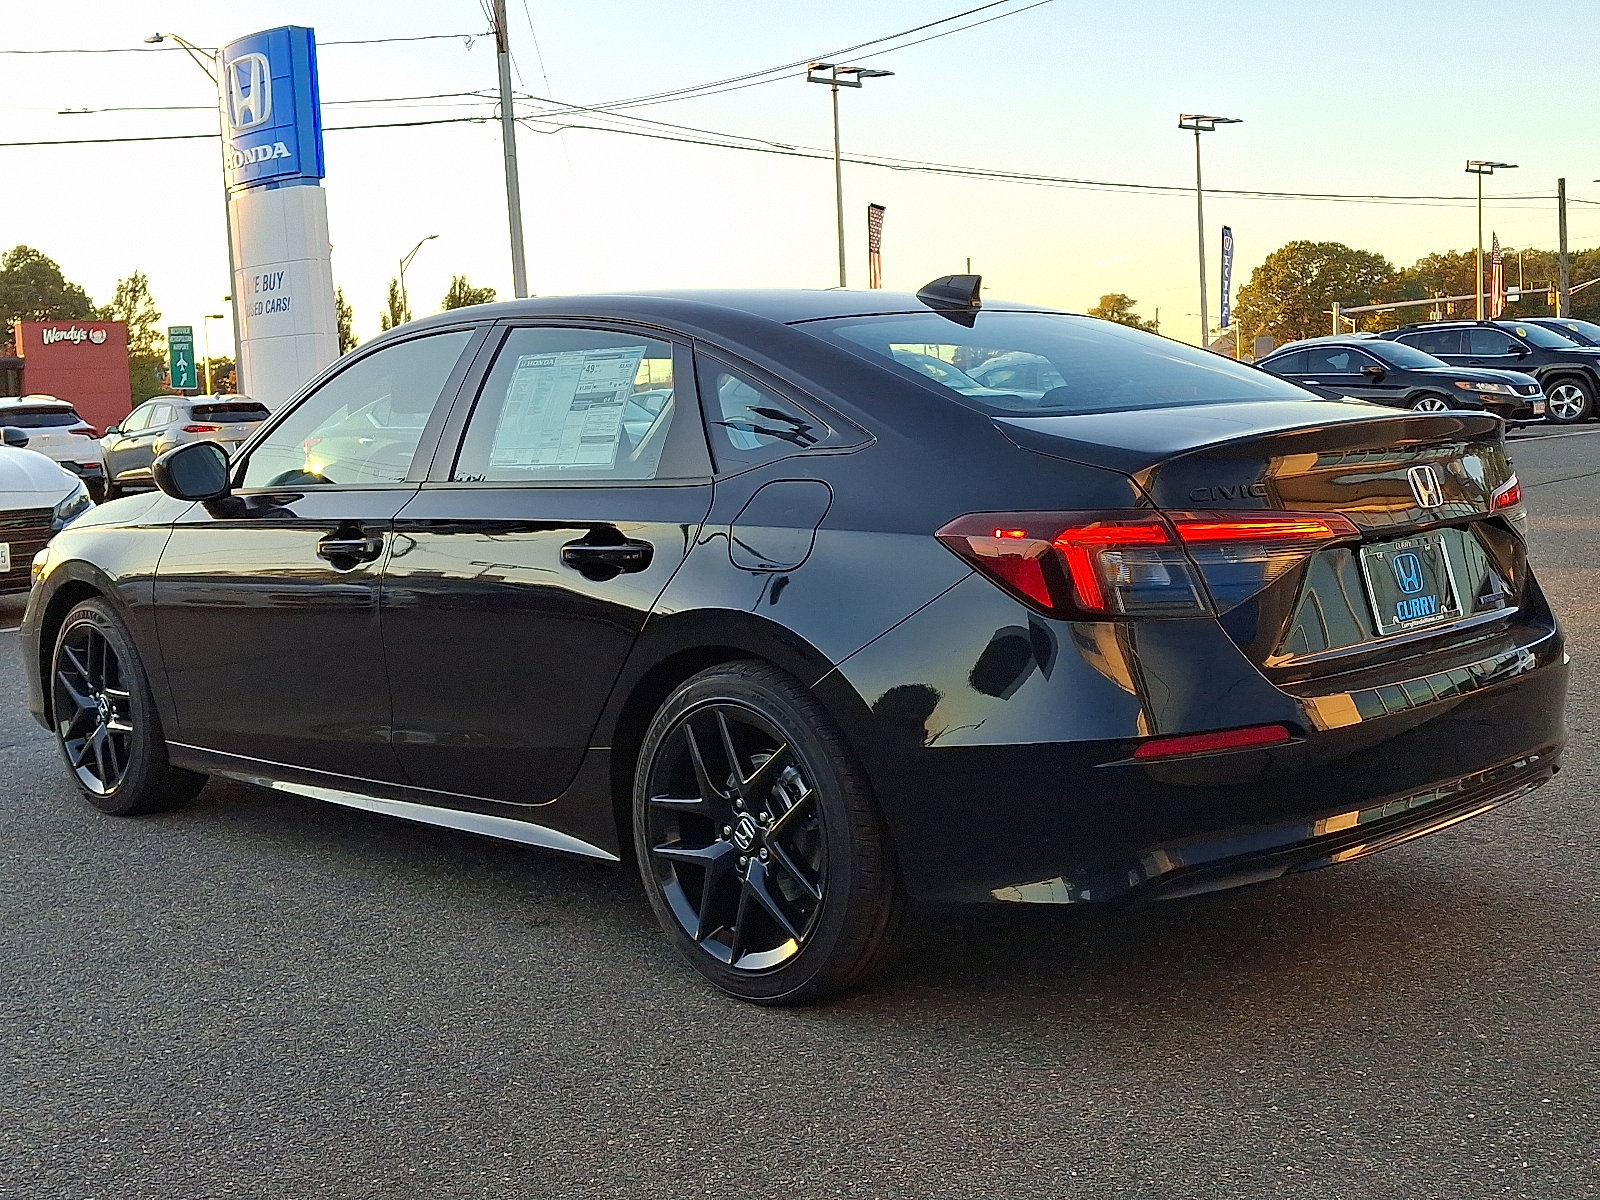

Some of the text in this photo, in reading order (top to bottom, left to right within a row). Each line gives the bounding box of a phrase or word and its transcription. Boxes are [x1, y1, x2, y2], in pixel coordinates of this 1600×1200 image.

[262, 270, 284, 292] BUY
[265, 296, 291, 314] CARS!
[42, 325, 88, 344] Wendy's
[1189, 483, 1268, 502] CIVIC
[1396, 594, 1437, 621] CURRY
